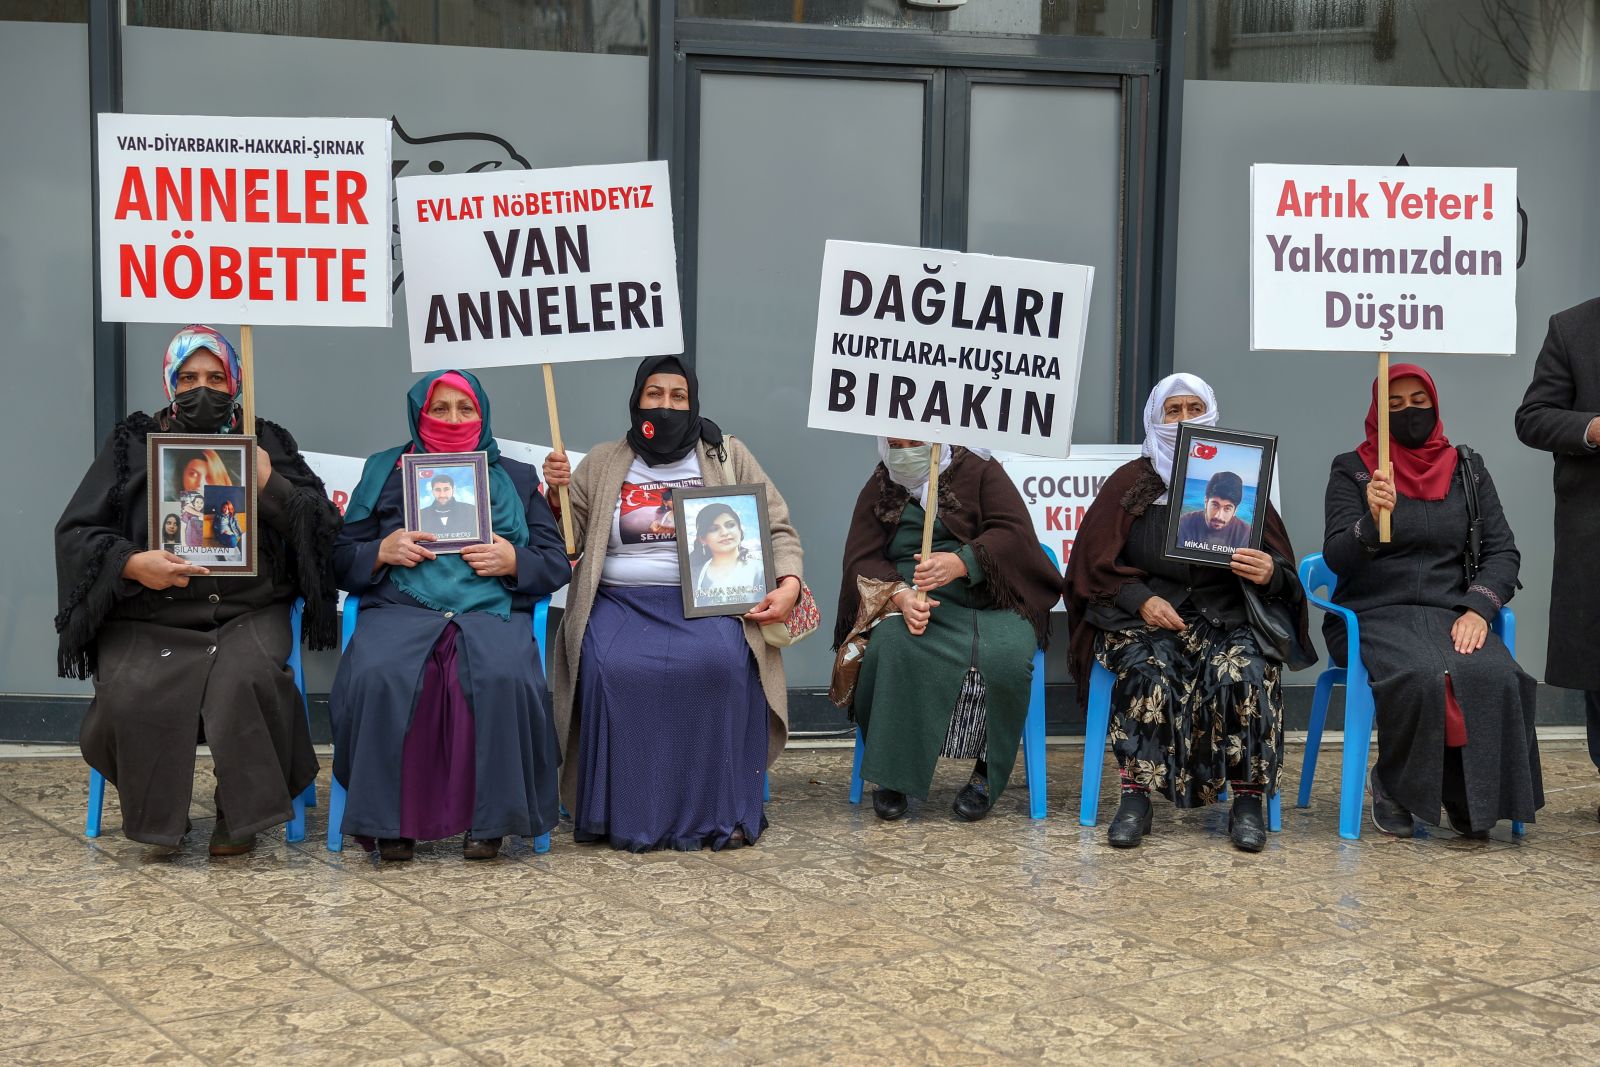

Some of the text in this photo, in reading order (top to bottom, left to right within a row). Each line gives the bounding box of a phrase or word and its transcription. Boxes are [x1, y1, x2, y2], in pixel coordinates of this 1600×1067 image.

[114, 166, 369, 224] ANNELER
[417, 196, 485, 223] EVLAT
[1276, 179, 1494, 221] Artık Yeter!
[119, 229, 367, 303] NÖBETTE
[483, 224, 591, 279] VAN
[1266, 234, 1502, 276] Yakamızdan
[839, 263, 1064, 339] DAĞLARI
[1325, 291, 1444, 341] Düşün
[831, 332, 1061, 380] KURTLARA-KUŞLARA
[827, 368, 1056, 438] BIRAKIN
[201, 546, 230, 554] DAYAN
[1184, 540, 1211, 551] MİKAİL
